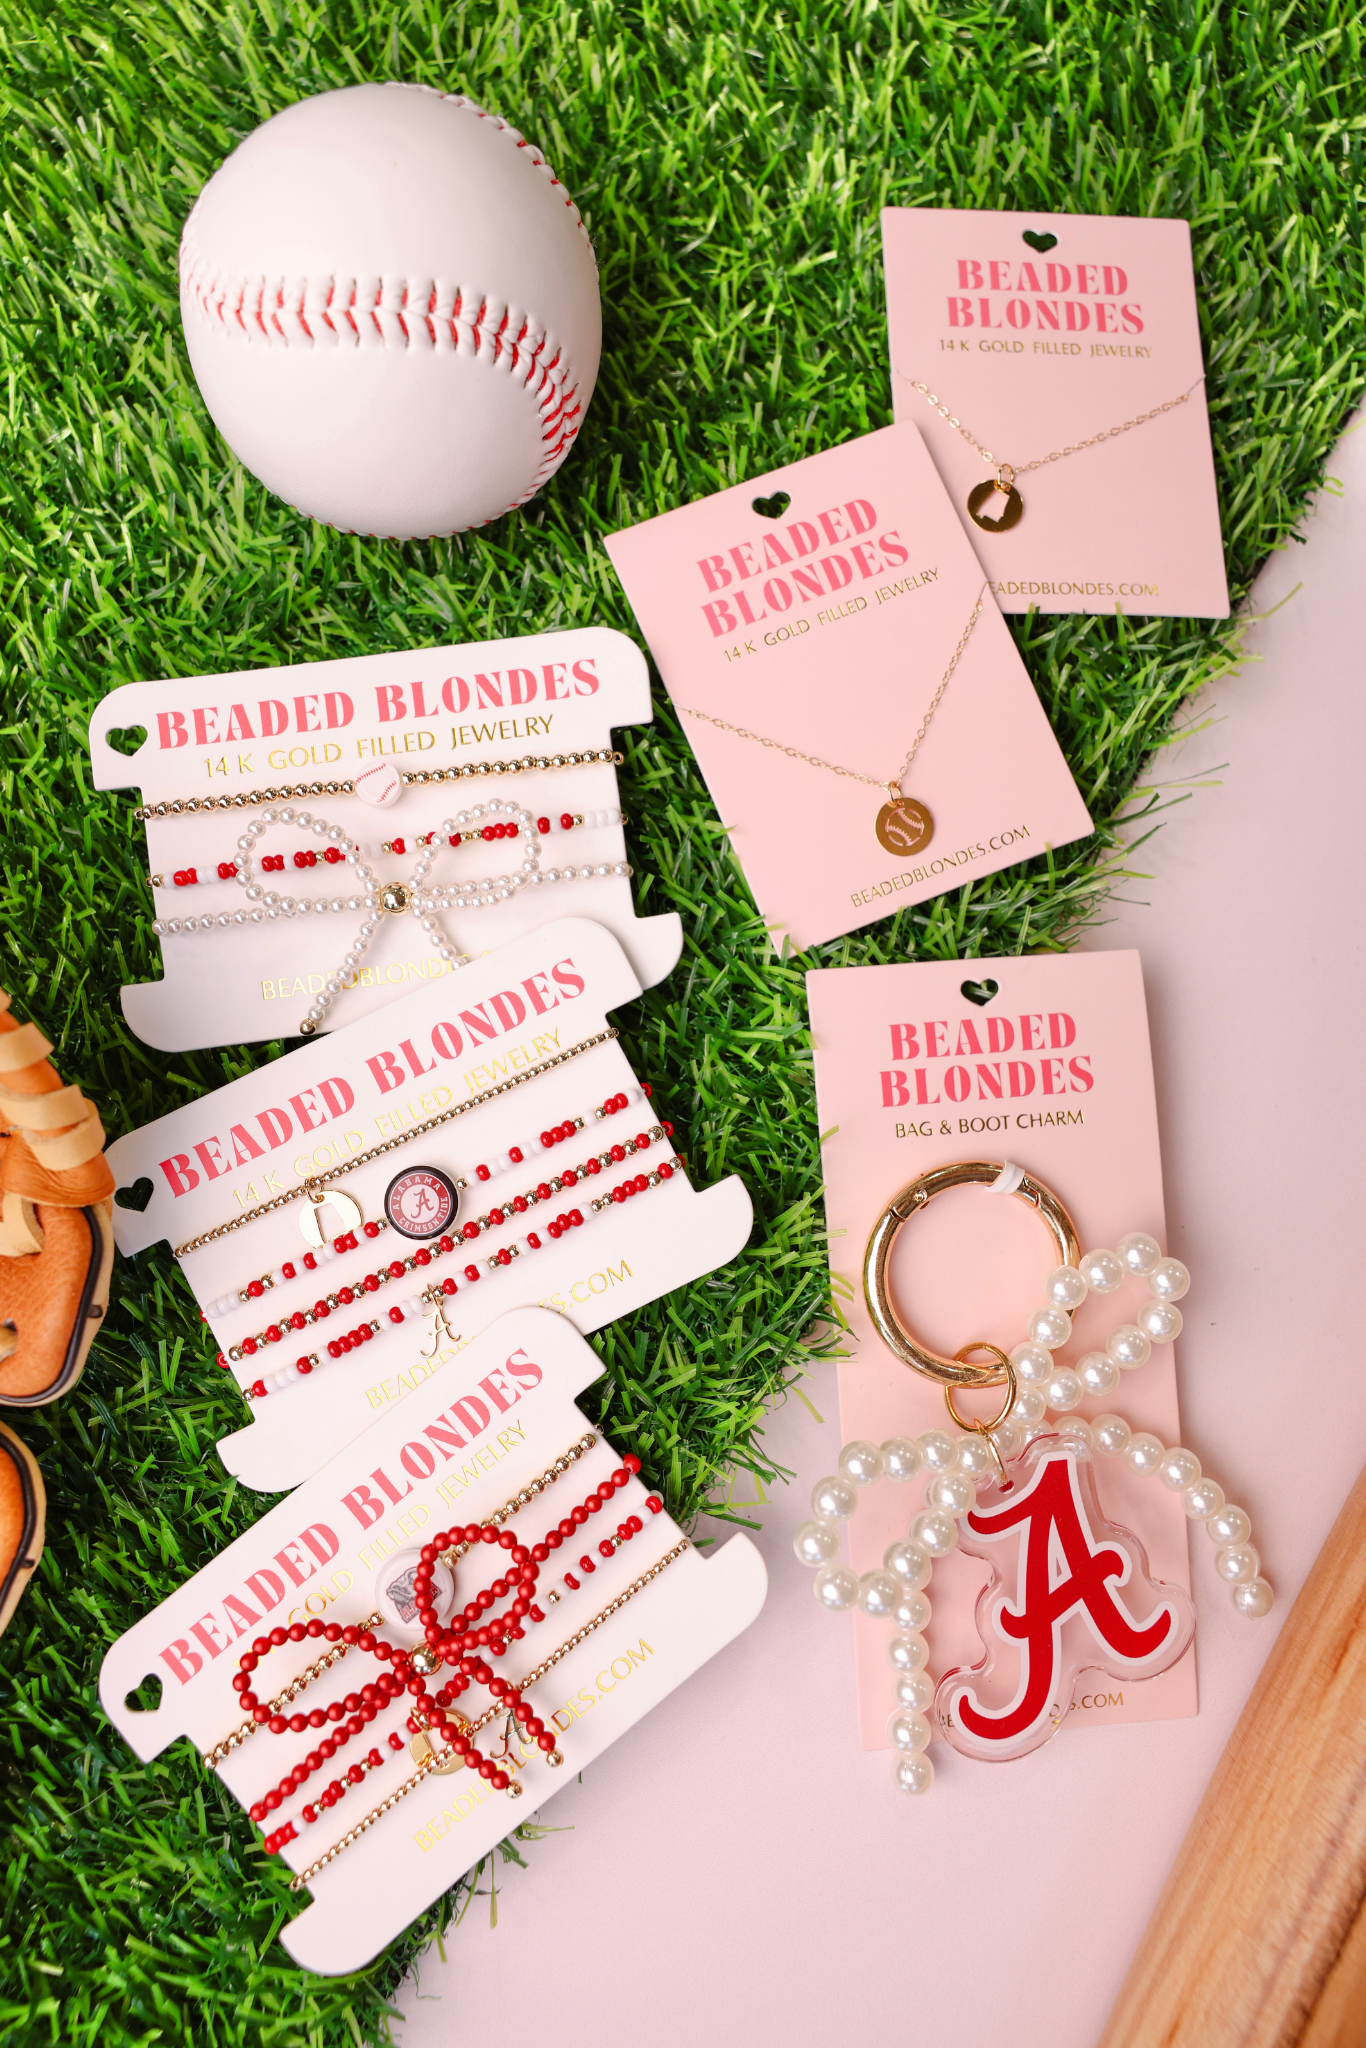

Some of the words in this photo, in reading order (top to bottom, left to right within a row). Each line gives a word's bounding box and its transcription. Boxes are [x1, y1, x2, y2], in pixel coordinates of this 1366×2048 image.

[956, 259, 1128, 296] BEADED
[946, 297, 1144, 335] BLONDES
[979, 340, 1024, 353] GOLD
[1033, 342, 1082, 356] FILLED
[1090, 344, 1152, 358] JEWELRY
[696, 499, 878, 593] BEADED
[700, 530, 909, 638] BLONDES
[763, 619, 811, 646] GOLD
[817, 596, 869, 626] FILLED
[874, 567, 940, 605] JEWELRY
[988, 580, 1159, 597] EADEDBLONDES.COM
[155, 691, 355, 750] BEADED
[374, 658, 600, 723] BLONDES
[268, 743, 342, 771] GOLD
[357, 730, 436, 759] FILLED
[451, 714, 554, 750] JEWELRY
[850, 824, 1031, 908] BEADEDBLONDES.COM
[889, 1012, 1076, 1061] BEADED
[158, 1076, 355, 1199] BEADED
[364, 958, 586, 1095] BLONDES
[294, 1130, 366, 1177] GOLD
[375, 1086, 453, 1137] FILLED
[463, 1027, 562, 1097] JEWELRY
[879, 1055, 1094, 1108] BLONDES
[895, 1121, 933, 1138] BAG
[939, 1119, 952, 1135] &
[958, 1115, 1010, 1134] BOOT
[1016, 1109, 1085, 1130] CHARM
[392, 1175, 441, 1210] ALABAMA
[410, 1188, 434, 1219] A
[399, 1217, 440, 1232] CRIMSON
[158, 1522, 340, 1686] BEADED
[340, 1348, 543, 1531] BLONDES
[358, 1504, 431, 1571] FILLED
[436, 1418, 527, 1509] JEWELRY
[959, 1459, 1171, 1740] A
